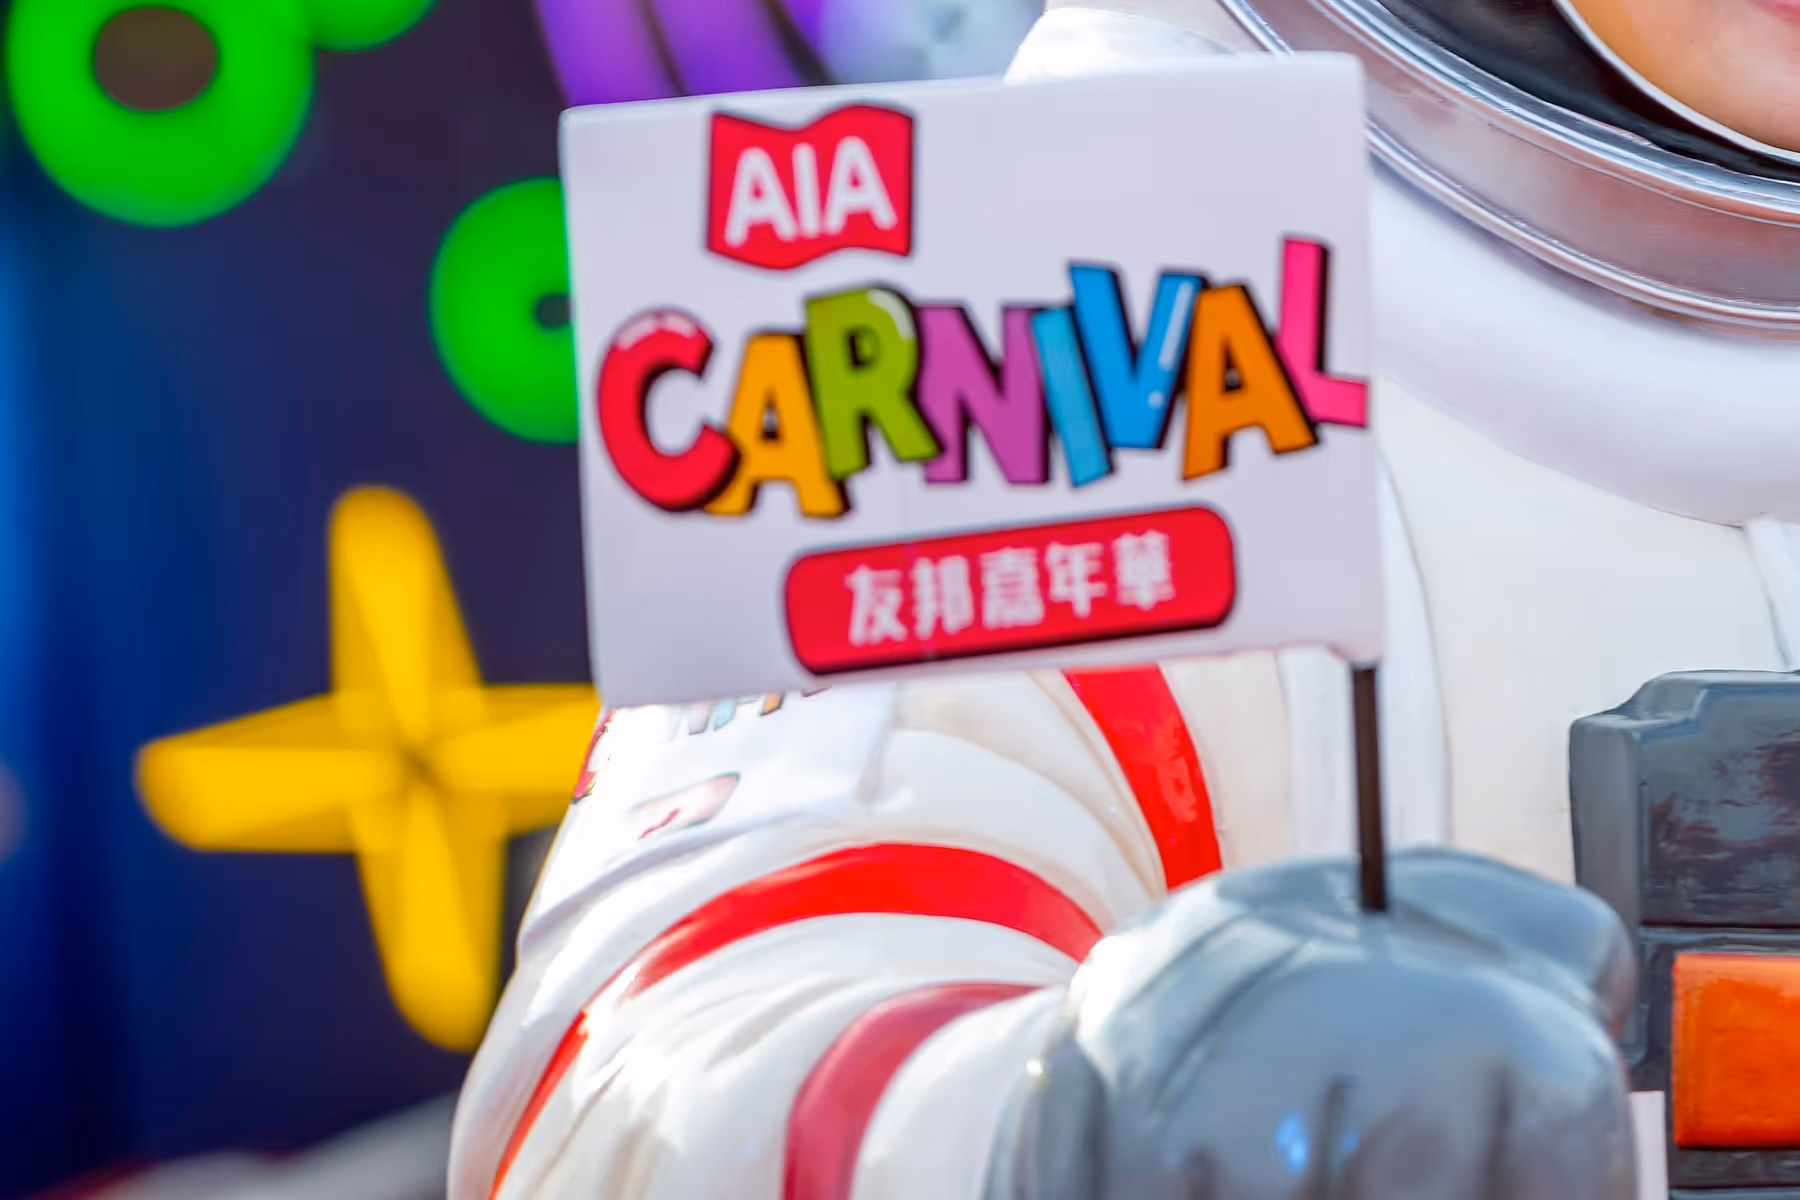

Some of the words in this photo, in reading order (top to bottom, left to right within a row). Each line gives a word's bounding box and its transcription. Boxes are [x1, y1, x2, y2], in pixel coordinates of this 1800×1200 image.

[724, 135, 899, 248] AIA
[597, 235, 1369, 518] CARNIVAL
[844, 529, 1177, 648] 友邦嘉年華
